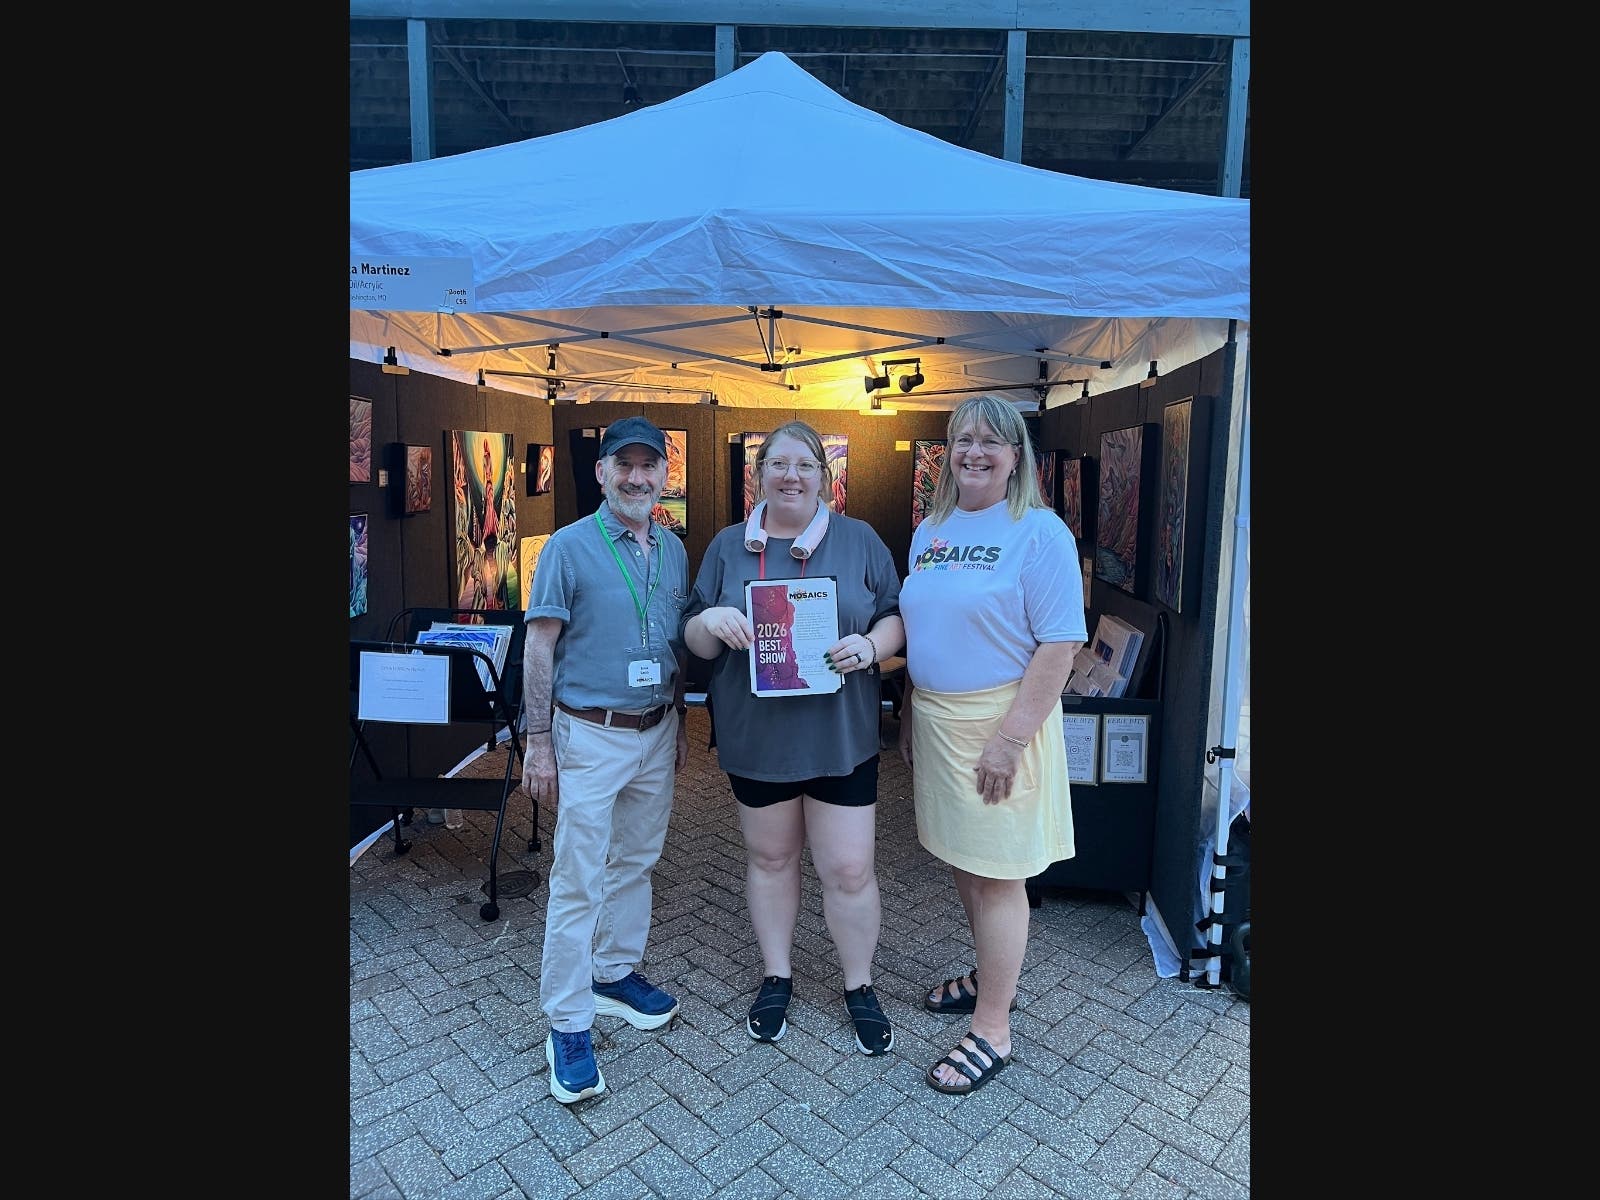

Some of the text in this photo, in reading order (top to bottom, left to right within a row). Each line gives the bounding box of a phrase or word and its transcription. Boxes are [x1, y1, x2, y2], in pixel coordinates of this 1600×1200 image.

[361, 263, 410, 275] Martinez
[449, 288, 467, 296] Booth
[934, 563, 996, 571] FINE ART FESTIVAL
[757, 623, 787, 637] 2026
[759, 640, 781, 651] BEST
[760, 653, 786, 663] SHOW
